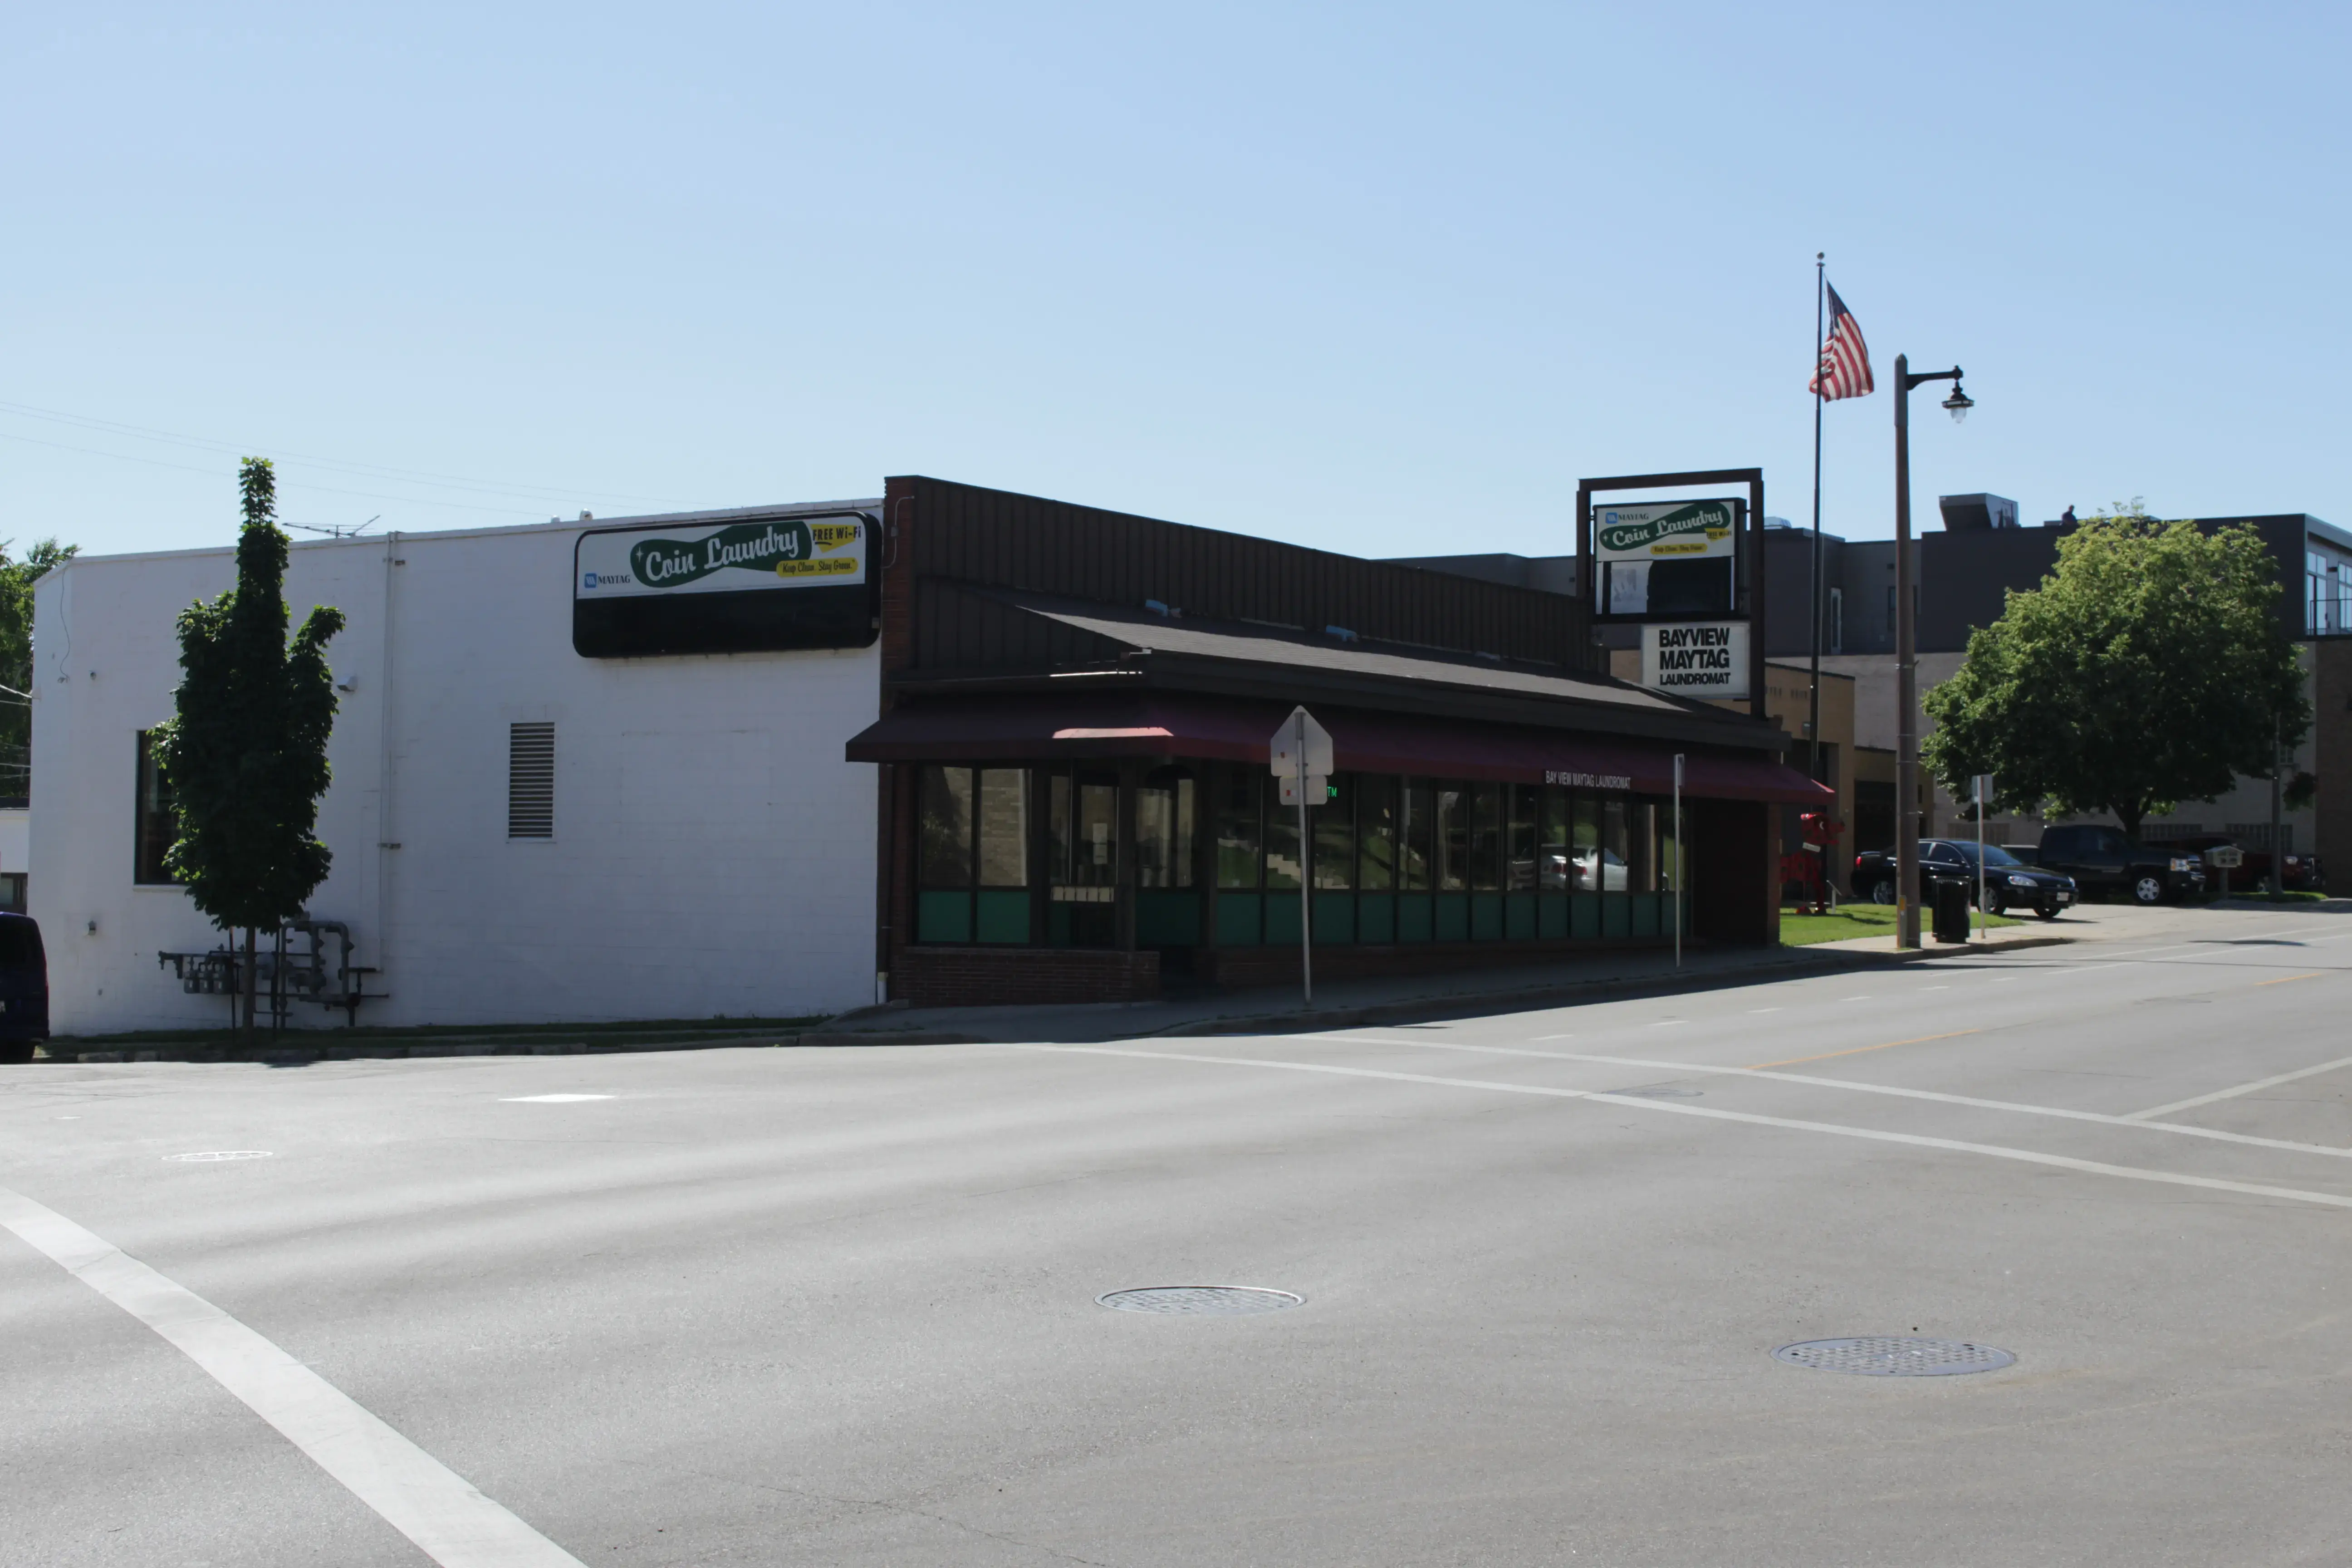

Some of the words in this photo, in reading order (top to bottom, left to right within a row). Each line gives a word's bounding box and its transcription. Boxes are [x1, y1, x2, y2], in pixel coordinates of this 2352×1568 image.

[813, 528, 833, 541] FREE
[836, 526, 861, 539] Wi-Fi
[1612, 528, 1651, 546] Coin
[1656, 510, 1723, 536] Laundry
[646, 549, 696, 581] Coin
[704, 526, 799, 558] Laundry
[818, 560, 832, 573] Stay
[598, 574, 630, 584] MAYTAG
[1659, 627, 1730, 647] BAYVIEW
[1660, 648, 1730, 670] MAYTAG
[1660, 672, 1731, 686] LAUNDROMAT
[1546, 770, 1557, 784] BAY
[1558, 772, 1572, 785] VIEW
[1573, 773, 1594, 787] MAYTAG
[1595, 775, 1631, 790] LAUNDROMAT
[1328, 786, 1337, 797] TM
